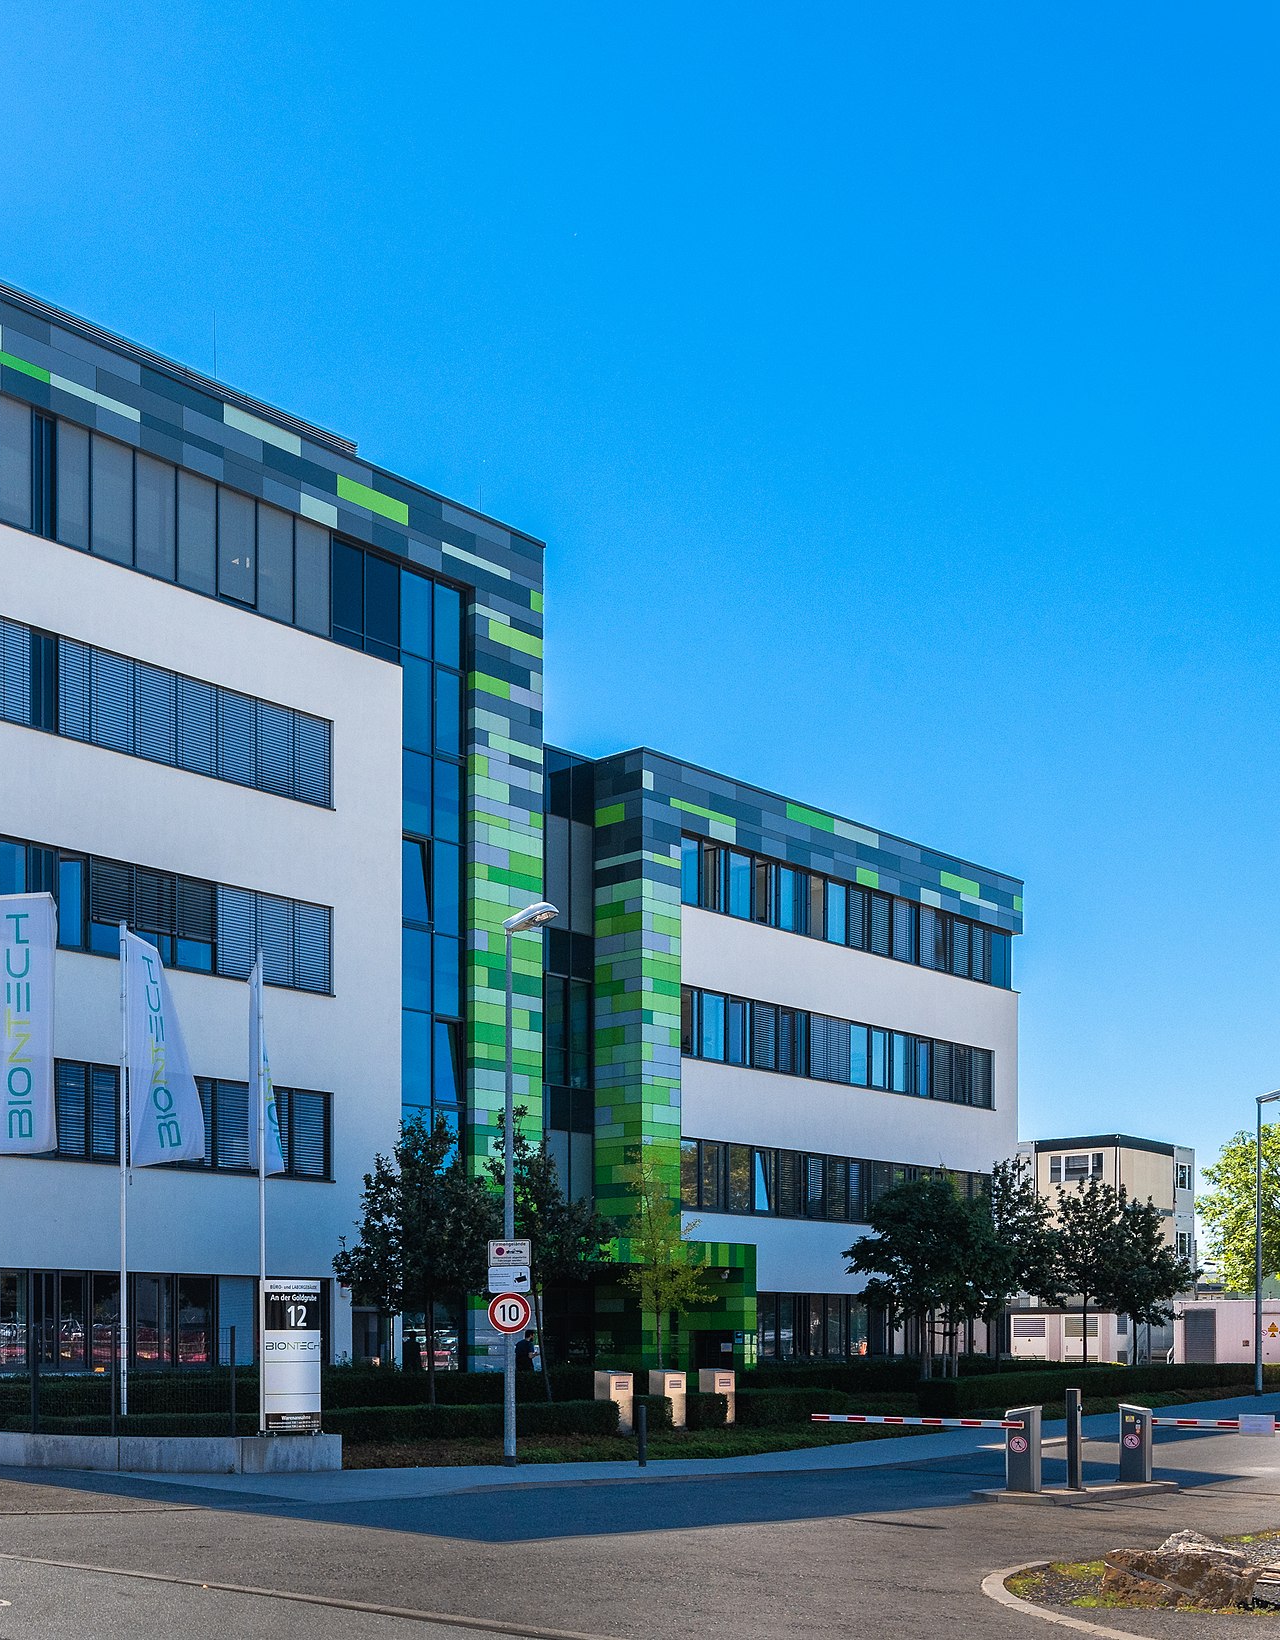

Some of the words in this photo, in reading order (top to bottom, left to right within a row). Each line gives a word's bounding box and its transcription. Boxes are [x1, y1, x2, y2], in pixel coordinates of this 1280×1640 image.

[5, 913, 33, 1139] BIONTECH
[141, 955, 182, 1149] BIONTECH
[287, 1305, 307, 1326] 12
[499, 1304, 519, 1321] 10
[265, 1341, 320, 1351] BIONTECH
